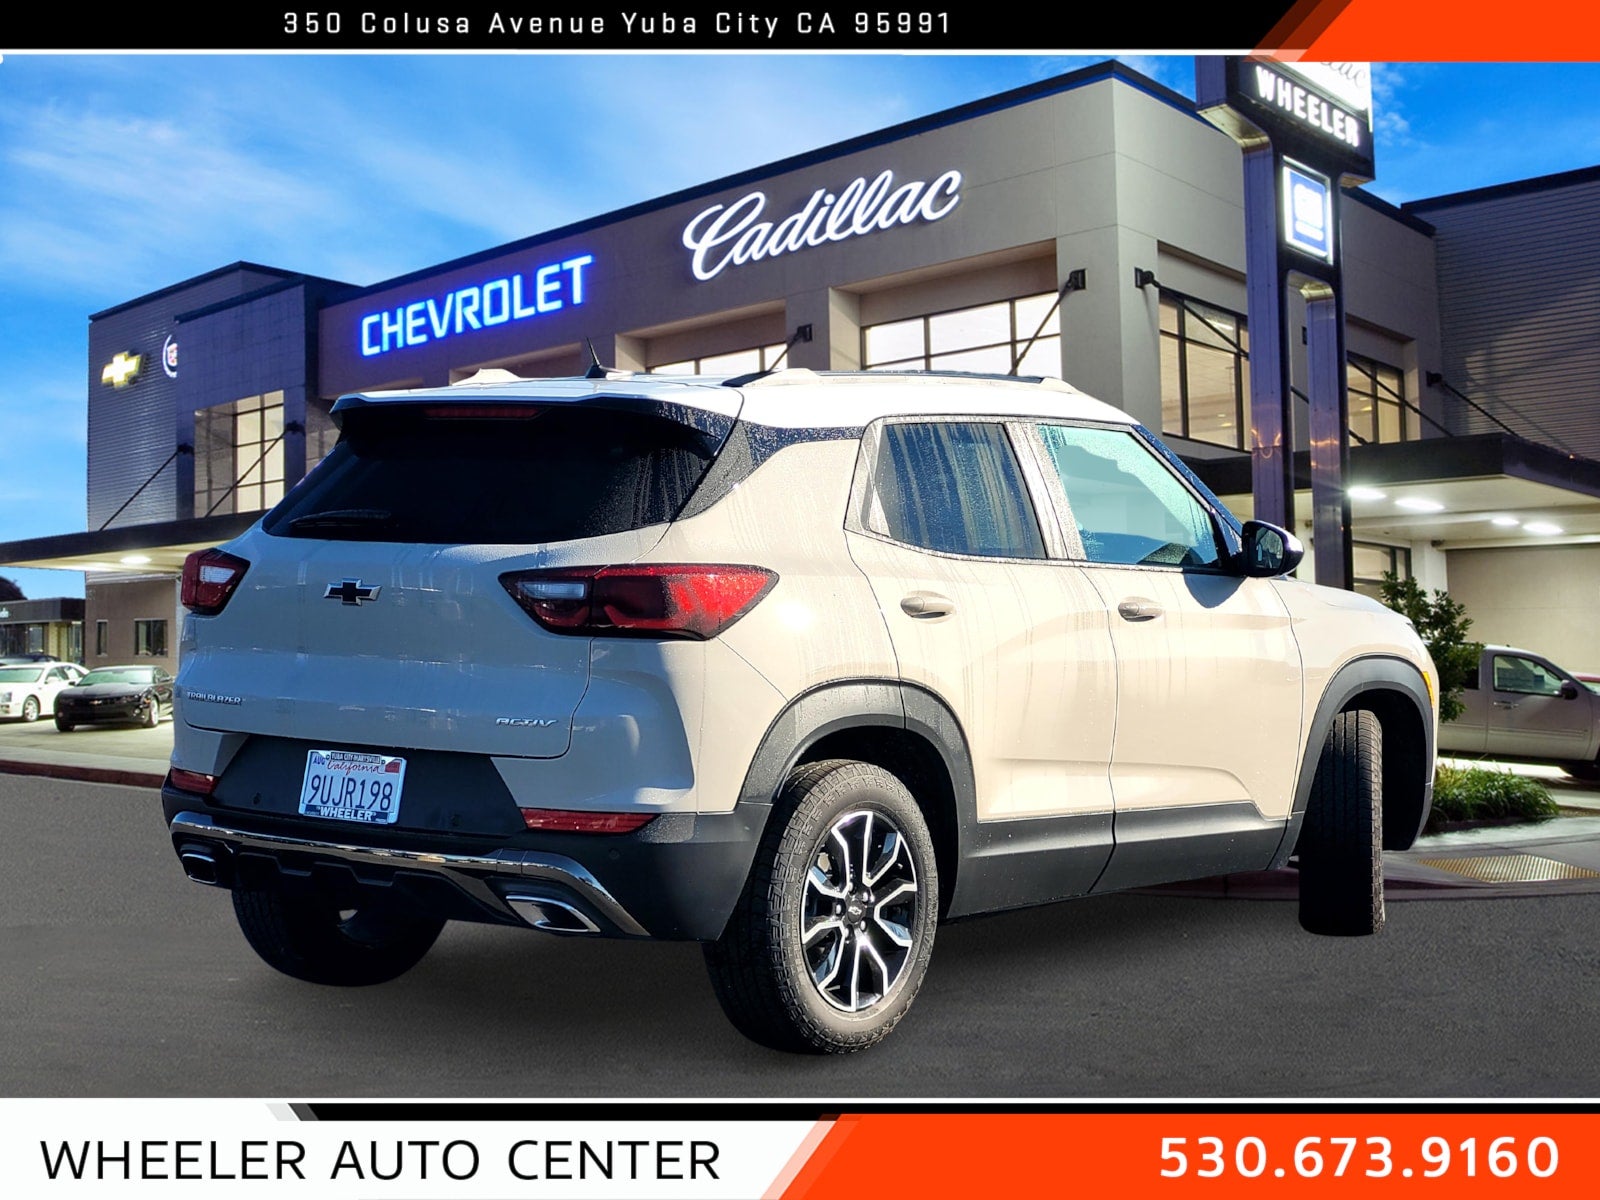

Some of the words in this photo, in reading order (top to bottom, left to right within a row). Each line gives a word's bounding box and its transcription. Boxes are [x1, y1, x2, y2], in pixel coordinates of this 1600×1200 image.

[1255, 65, 1359, 147] WHEELER
[682, 169, 963, 281] Cadillac
[361, 255, 594, 356] CHEVROLET
[187, 691, 241, 705] TRAILBLAZER
[496, 717, 557, 727] ACTIV
[327, 760, 384, 775] California
[308, 775, 392, 811] 9UJR198
[320, 806, 372, 821] WHEELER
